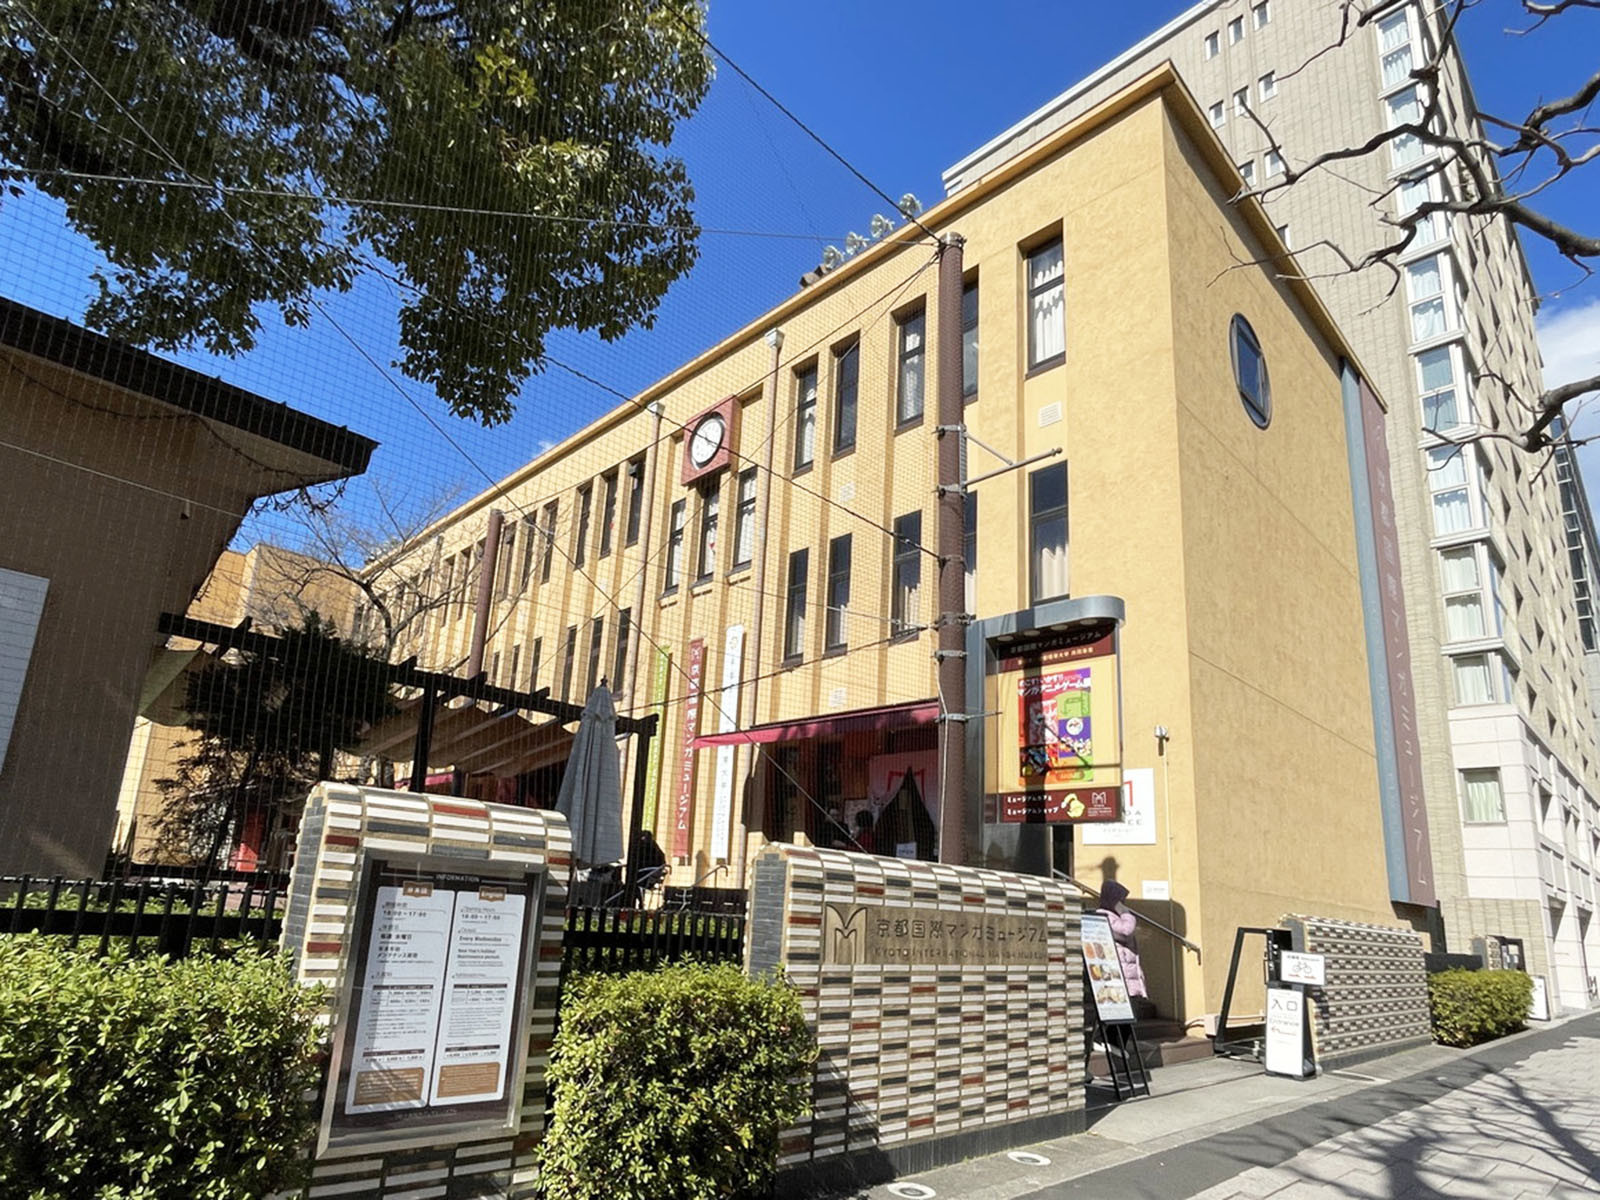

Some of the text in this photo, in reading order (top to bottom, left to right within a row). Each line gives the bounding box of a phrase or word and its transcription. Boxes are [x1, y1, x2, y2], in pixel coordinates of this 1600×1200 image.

[436, 874, 480, 883] INFORMATION
[875, 918, 1047, 943] 京都国際マンガミュージアム
[875, 948, 909, 958] KYOTO
[1271, 999, 1298, 1012] 入口
